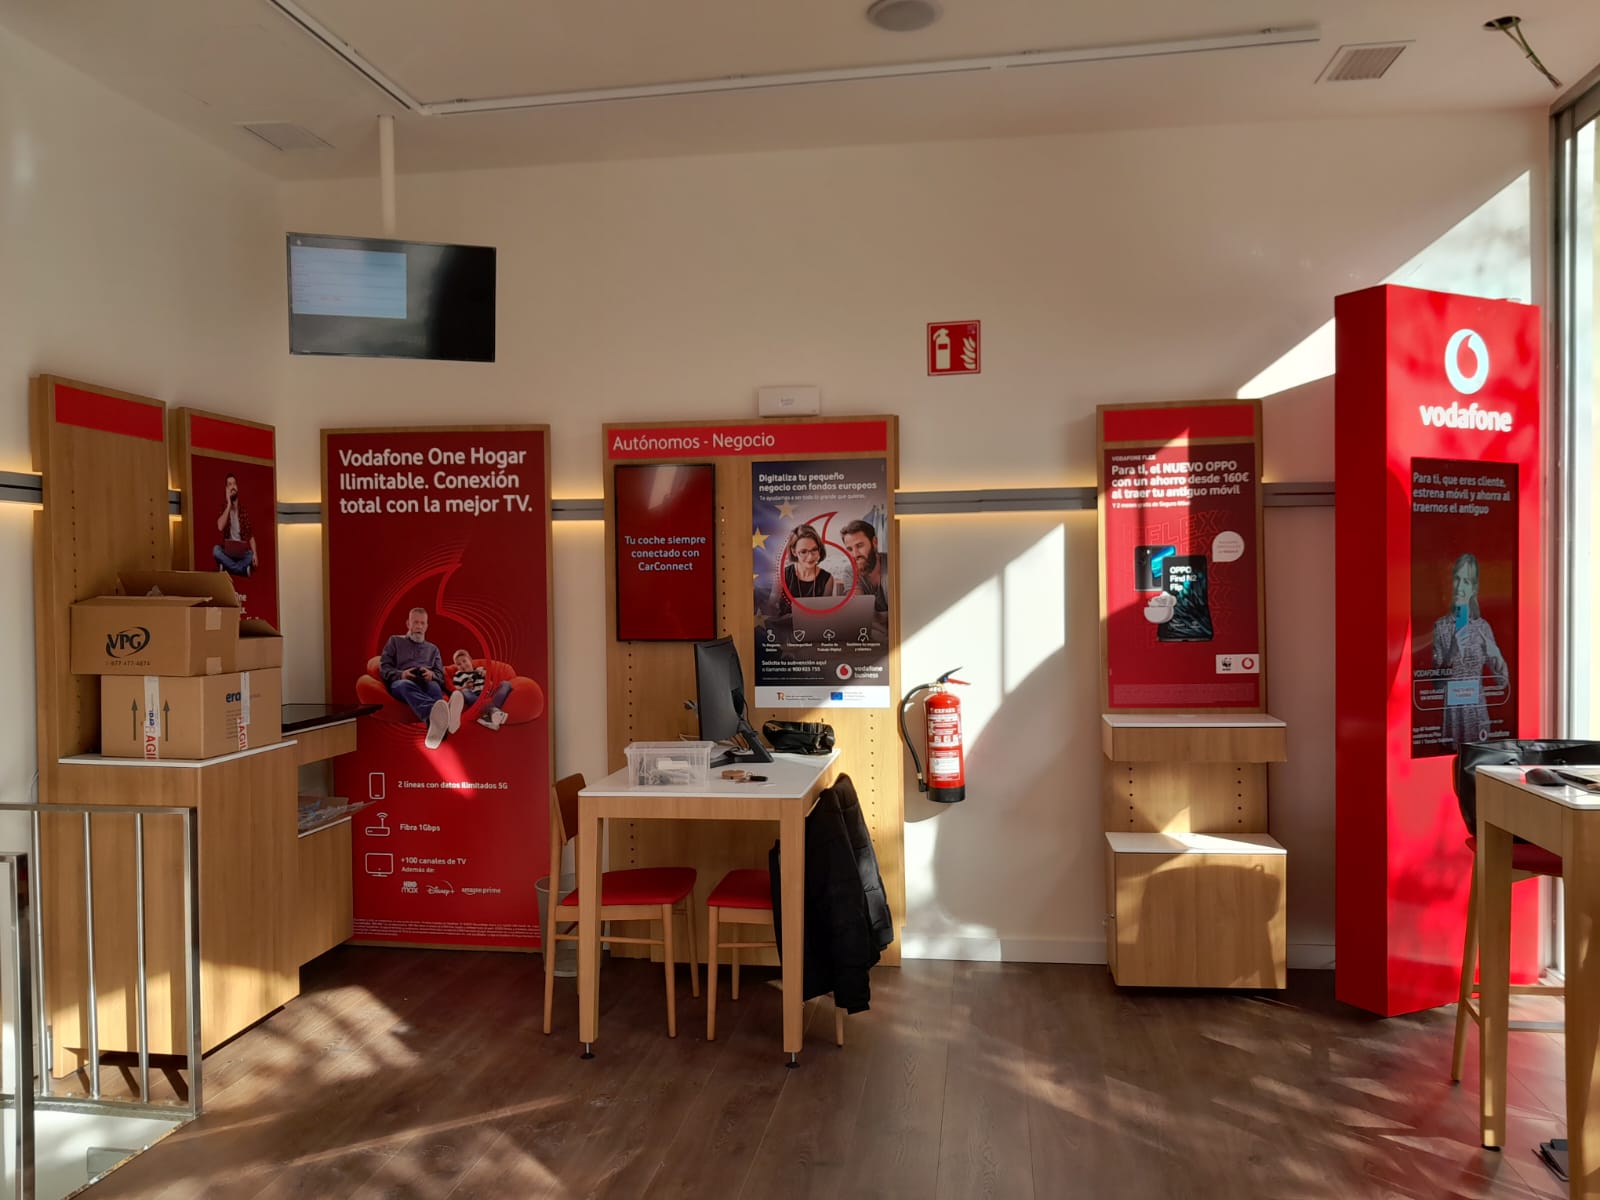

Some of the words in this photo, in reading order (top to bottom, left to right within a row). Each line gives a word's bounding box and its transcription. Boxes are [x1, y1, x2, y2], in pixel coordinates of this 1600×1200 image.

[1419, 401, 1512, 432] vodafone
[613, 434, 700, 451] Autónomos
[712, 432, 775, 451] Negocio
[339, 449, 423, 467] Vodafone
[428, 448, 466, 465] One
[470, 447, 527, 468] Hogar
[1112, 465, 1135, 475] Para
[1137, 464, 1149, 475] ti,
[1150, 463, 1161, 474] el
[1163, 462, 1203, 474] NUEVO
[1205, 460, 1237, 472] OPPO
[340, 472, 429, 490] Ilimitable.
[433, 470, 520, 489] Conexión
[758, 473, 797, 483] Digitaliza
[808, 472, 845, 483] pequeño
[1112, 477, 1132, 487] con
[1133, 477, 1147, 486] un
[1150, 475, 1186, 486] ahorro
[1188, 474, 1220, 484] desde
[1222, 472, 1249, 483] 160€
[1413, 472, 1431, 484] Para
[1442, 476, 1457, 487] que
[1459, 477, 1476, 486] eres
[758, 483, 791, 493] negocio
[792, 483, 807, 491] con
[808, 482, 837, 490] fondos
[838, 482, 877, 491] europeos
[1111, 488, 1122, 499] al
[1123, 487, 1150, 499] traer
[1152, 487, 1165, 497] tu
[1165, 485, 1207, 498] antiguo
[1209, 485, 1240, 495] móvil
[1413, 488, 1444, 498] estrena
[1446, 488, 1469, 499] móvil
[1470, 491, 1476, 502] y
[1476, 490, 1501, 500] ahorra
[1502, 491, 1511, 501] al
[340, 497, 382, 514] total
[386, 500, 419, 514] con
[424, 496, 441, 513] la
[445, 495, 500, 517] mejor
[503, 495, 533, 512] TV.
[1413, 502, 1448, 513] traernos
[1449, 503, 1457, 513] el
[1458, 503, 1489, 516] antiguo
[625, 535, 636, 545] Tu
[638, 535, 666, 545] coche
[667, 535, 706, 546] siempre
[631, 550, 680, 558] conectado
[638, 562, 693, 571] CarConnect
[1169, 565, 1192, 574] OPPO
[1169, 574, 1186, 583] Find
[1169, 583, 1183, 592] Flip
[107, 633, 142, 650] VPG
[403, 781, 425, 789] líneas
[419, 824, 440, 832] 1Gbps
[418, 857, 445, 865] canales
